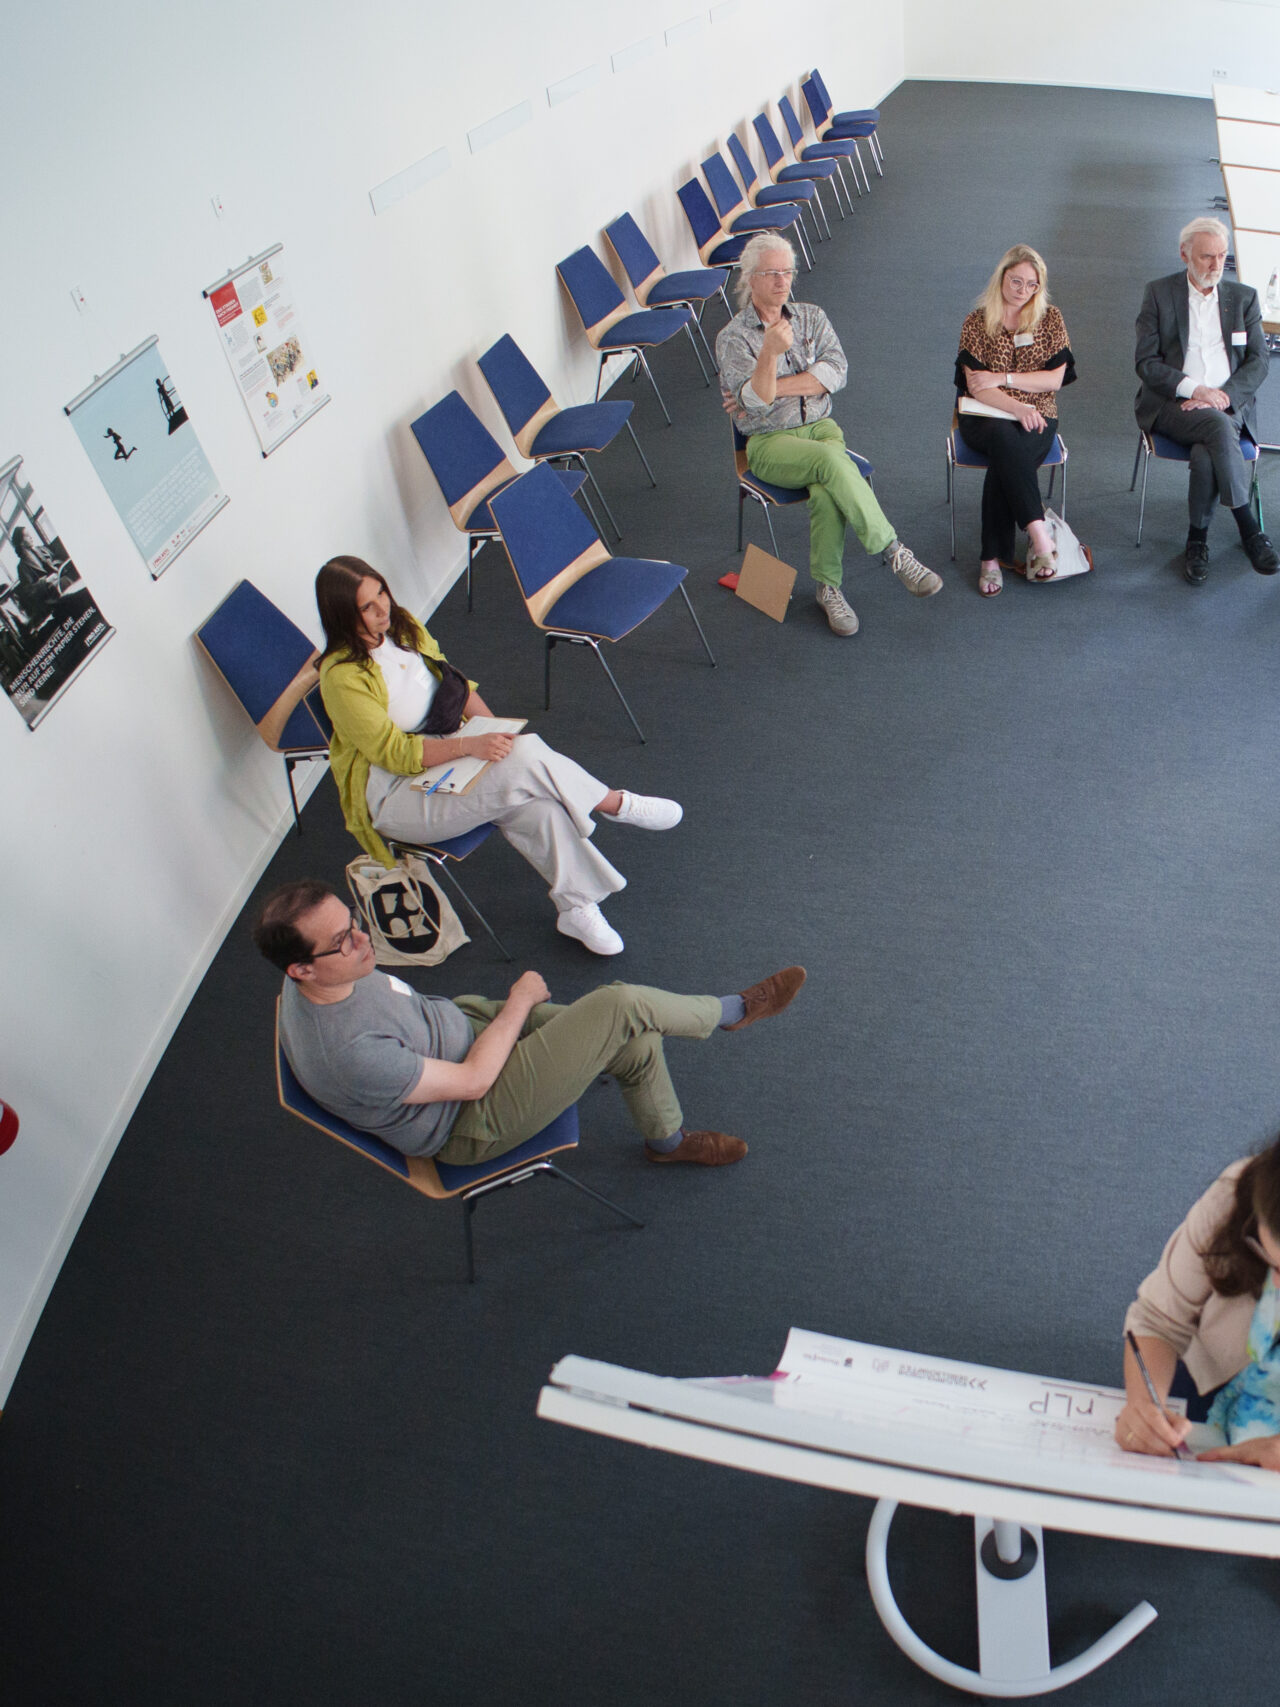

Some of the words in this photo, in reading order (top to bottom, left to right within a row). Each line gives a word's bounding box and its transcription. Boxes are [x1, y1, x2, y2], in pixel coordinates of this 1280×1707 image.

[9, 630, 65, 692] MENSCHENRECHTE,
[63, 616, 75, 631] DIE
[14, 681, 30, 700] NUR
[27, 667, 41, 684] AUF
[39, 651, 57, 671] DEM
[53, 630, 75, 655] PAPIER
[72, 606, 97, 633] STEHEN,
[19, 687, 36, 708] SIND
[33, 665, 56, 690] KEINE!
